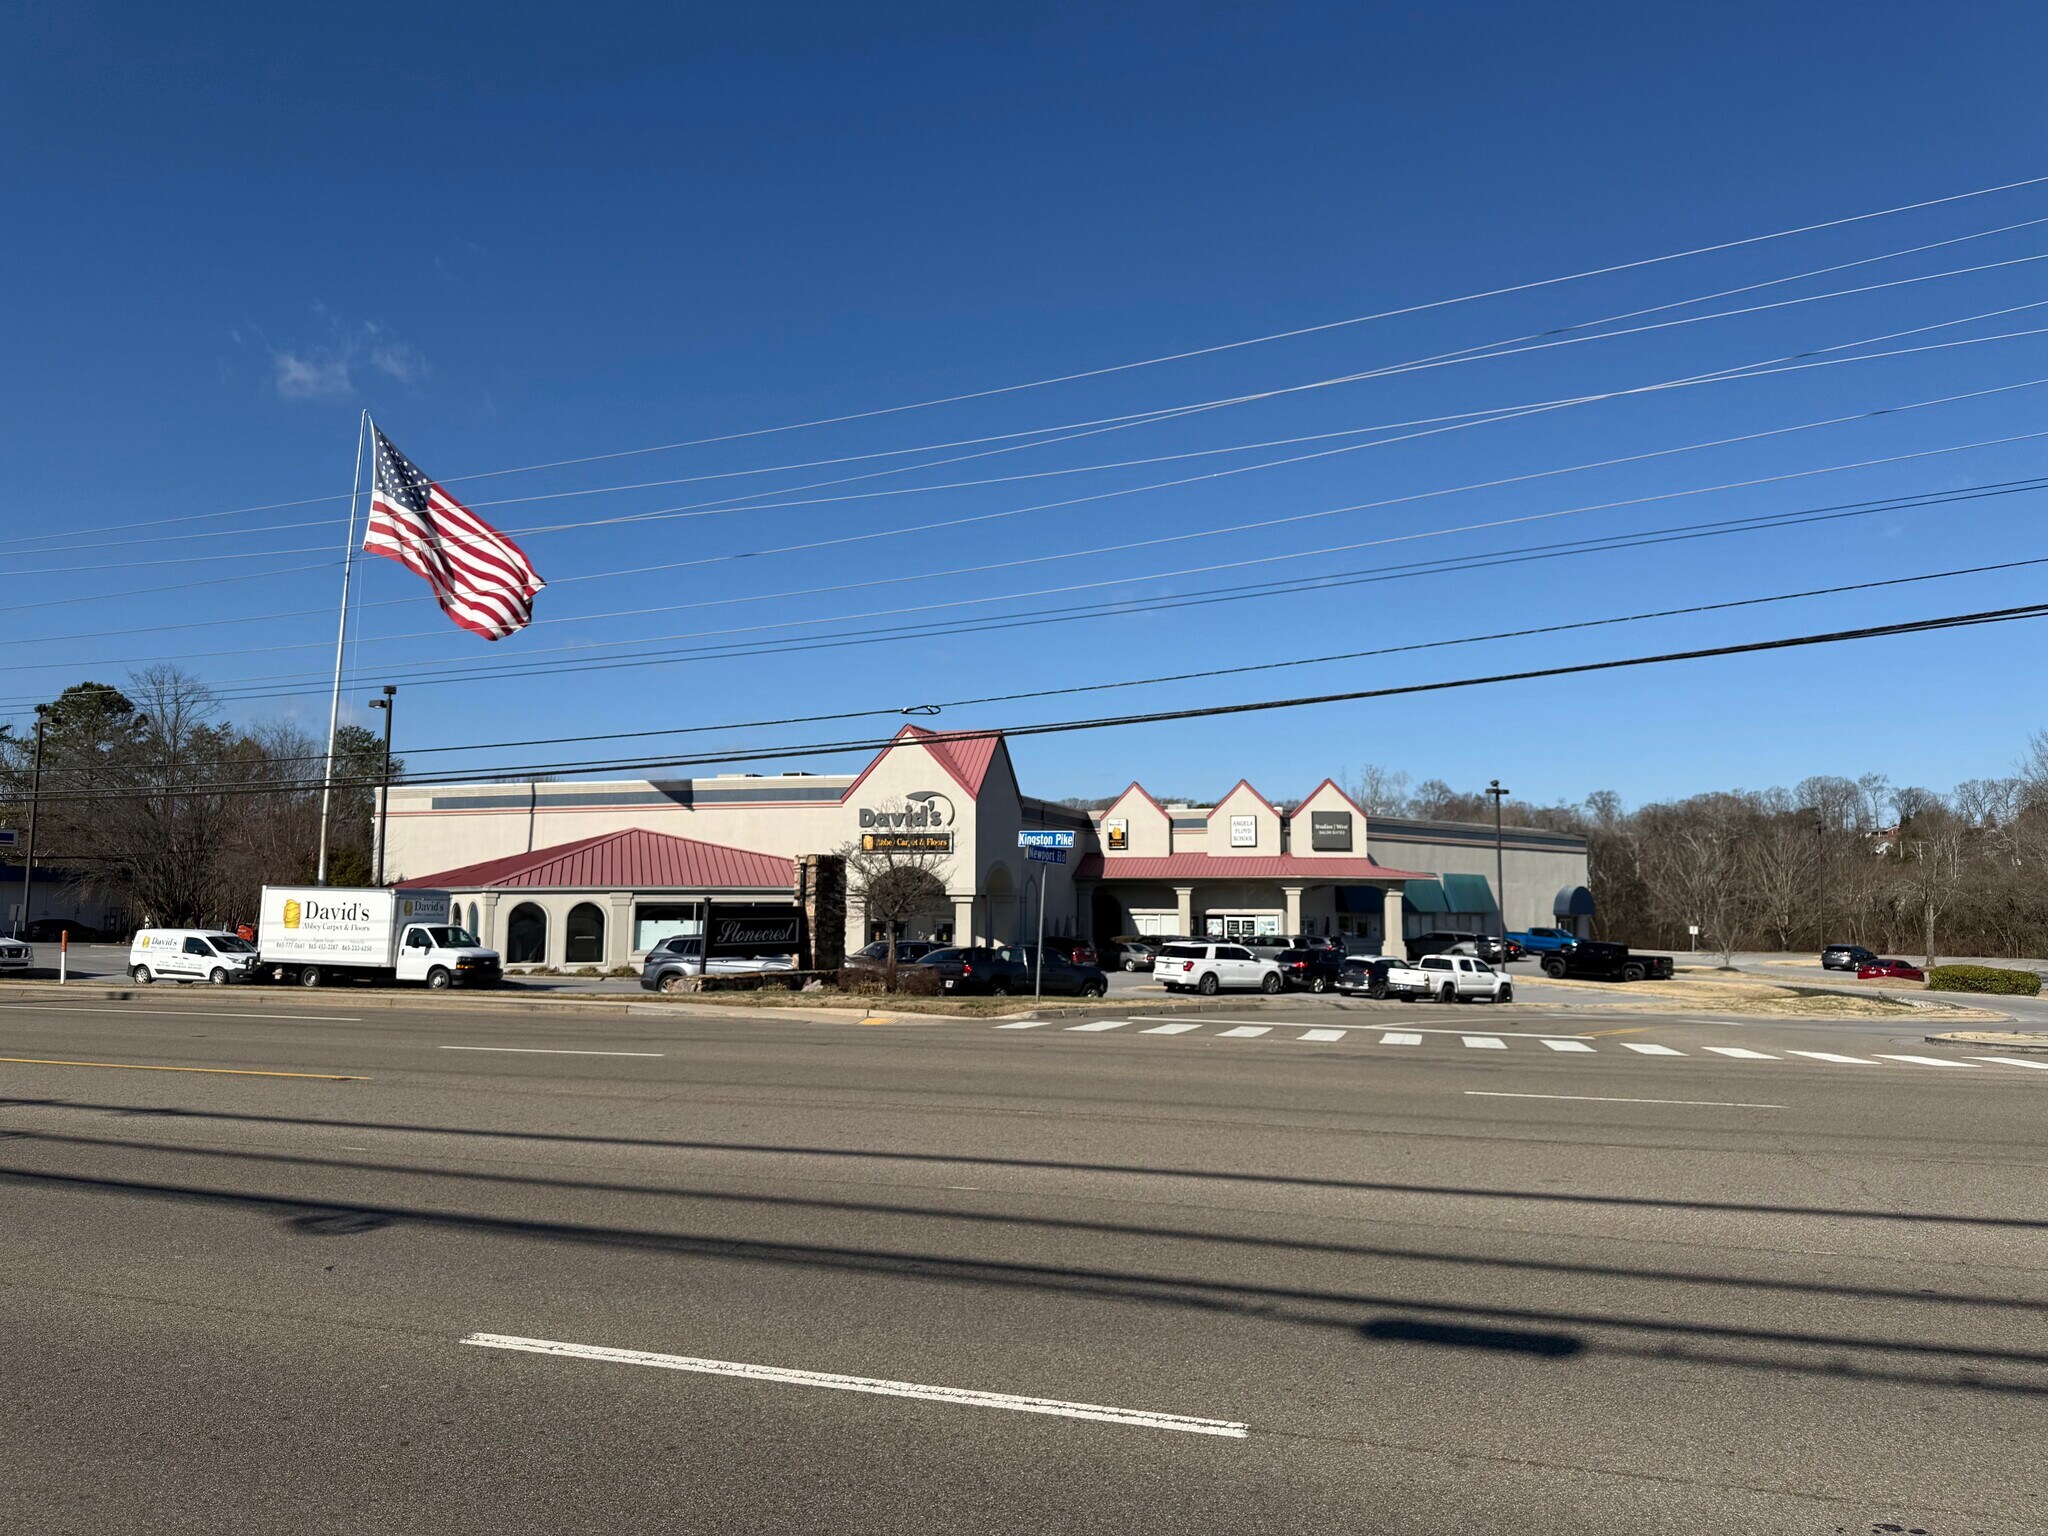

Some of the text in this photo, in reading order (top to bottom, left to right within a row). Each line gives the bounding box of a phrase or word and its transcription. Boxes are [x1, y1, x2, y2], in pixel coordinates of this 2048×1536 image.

[859, 800, 942, 828] David's
[1019, 833, 1073, 846] Kingston Pike
[1029, 847, 1066, 863] Newport Rd
[305, 901, 370, 921] David's
[414, 901, 444, 911] David's
[302, 922, 321, 931] Abbey
[322, 923, 343, 932] Carpet
[716, 920, 794, 942] Stonecrest
[151, 937, 177, 946] David's
